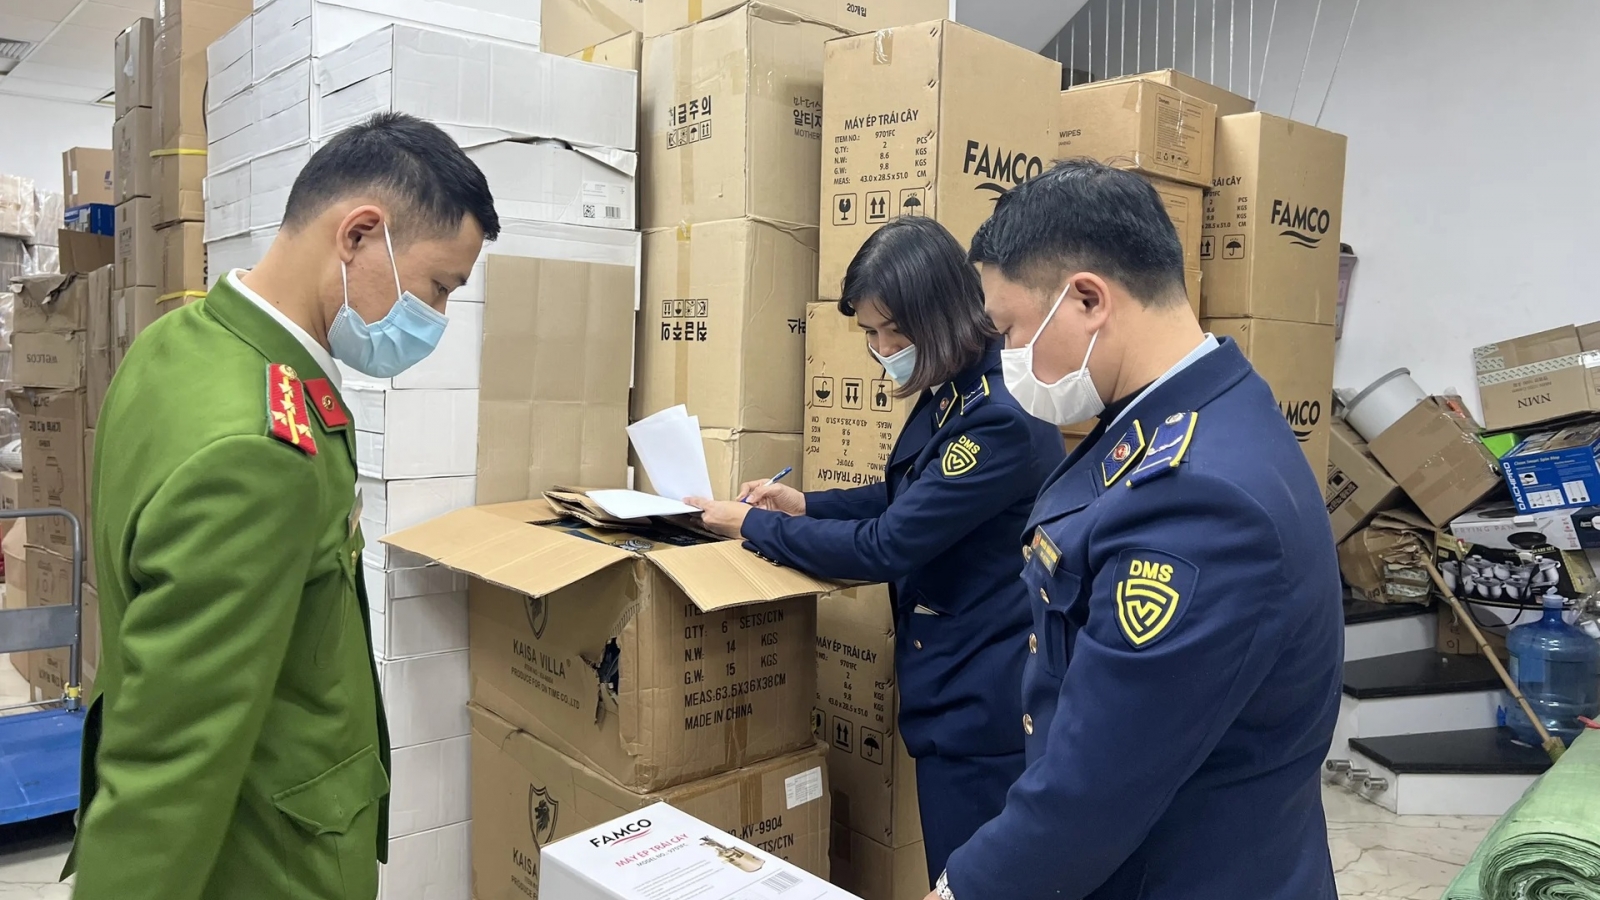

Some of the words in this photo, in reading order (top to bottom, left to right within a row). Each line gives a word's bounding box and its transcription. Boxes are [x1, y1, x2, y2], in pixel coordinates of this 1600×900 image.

[844, 117, 864, 130] MÁY
[866, 114, 877, 128] ÉP
[879, 110, 899, 126] TRÁI
[900, 108, 919, 122] CÂY
[875, 130, 896, 138] 9701FC
[882, 141, 888, 149] 2
[916, 136, 928, 145] PCS
[1059, 129, 1082, 138] WIPES
[834, 156, 848, 164] N.W:
[880, 152, 890, 160] 8.6
[915, 148, 928, 156] KGS
[963, 140, 1043, 186] FAMCO
[834, 167, 848, 175] G.W:
[879, 162, 890, 170] 9.8
[914, 159, 927, 167] KGS
[834, 177, 850, 185] MEAS:
[860, 175, 873, 183] 43.0
[878, 174, 892, 182] 28.5
[896, 172, 908, 180] 51.0
[916, 170, 927, 178] CM
[1212, 176, 1224, 187] RÁI
[1226, 175, 1242, 186] CÂY
[1270, 199, 1330, 234] FAMCO
[661, 321, 708, 342] 취급주의
[1518, 392, 1552, 408] NMN
[958, 435, 980, 454] DMS
[818, 468, 832, 481] CÂY
[834, 470, 850, 483] TRÁI
[852, 473, 862, 486] ÉP
[1130, 560, 1174, 582] DMS
[685, 604, 703, 618] ITE
[685, 624, 708, 639] QTY:
[722, 621, 728, 634] 6
[740, 610, 784, 629] SETS/CTN
[685, 648, 704, 662] N.W:
[726, 640, 736, 654] 14
[761, 632, 778, 646] KGS
[816, 636, 832, 650] MÁY
[833, 639, 841, 652] ÉP
[843, 645, 860, 659] TRÁI
[862, 649, 877, 664] CÂY
[513, 638, 537, 664] KAISA
[540, 652, 566, 680] VILLA
[685, 670, 704, 684] G.W:
[726, 662, 736, 676] 15
[760, 653, 778, 668] KGS
[685, 712, 712, 730] MADE
[714, 710, 722, 724] IN
[726, 703, 752, 720] CHINA
[590, 818, 652, 848] FAMCO
